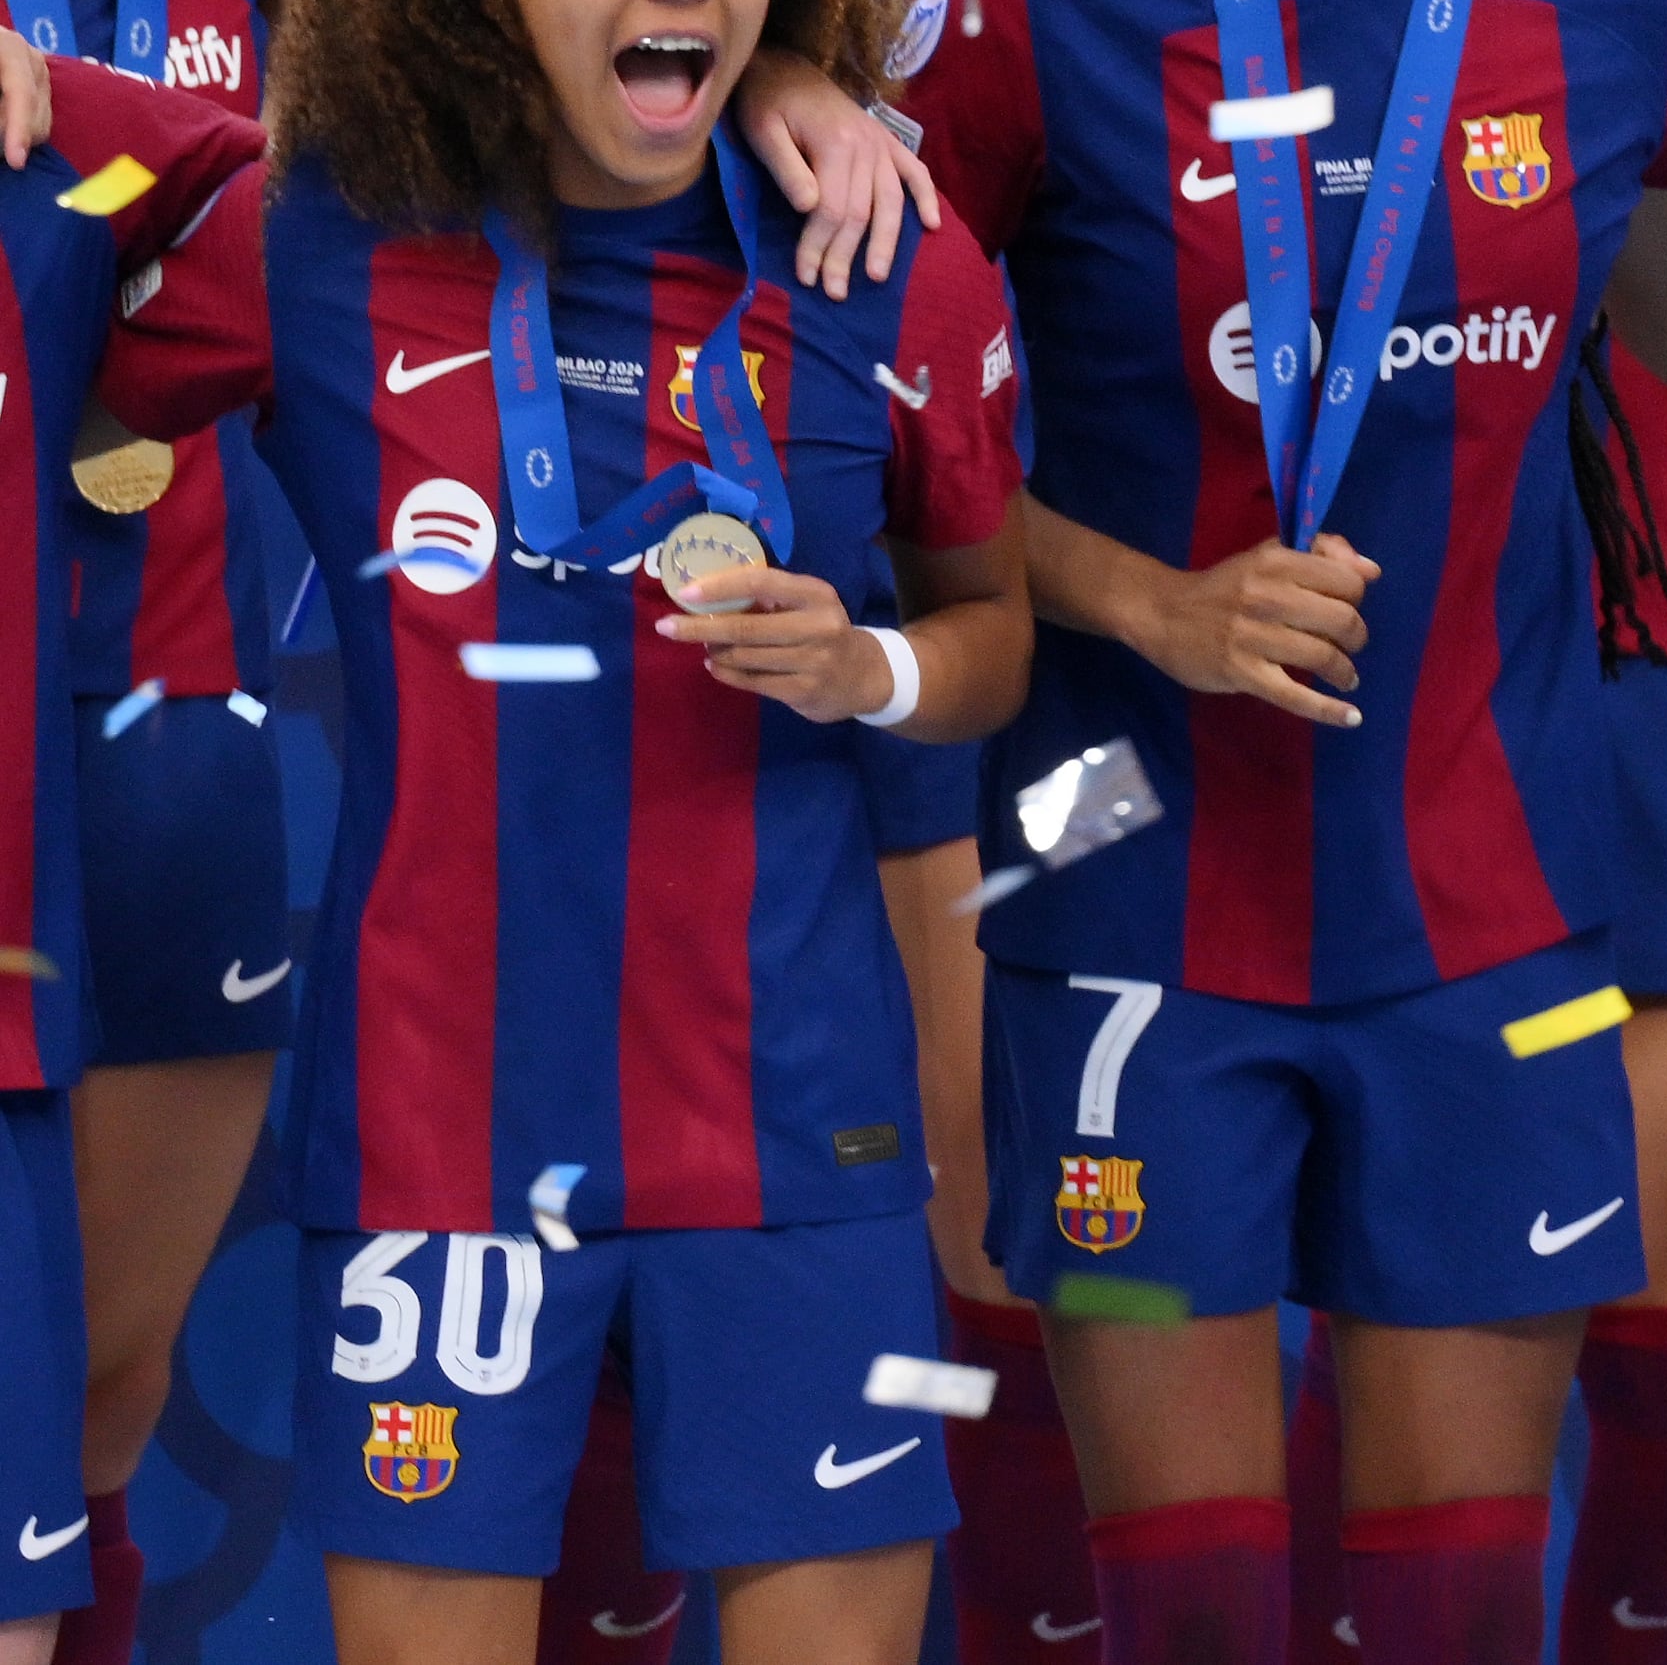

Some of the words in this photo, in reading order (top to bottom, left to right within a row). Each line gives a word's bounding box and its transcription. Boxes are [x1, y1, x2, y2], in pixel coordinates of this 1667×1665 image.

[165, 24, 242, 91] tify
[1388, 93, 1431, 195] FINAL
[1261, 175, 1288, 284] FINAL
[1379, 207, 1399, 235] 24
[1357, 238, 1392, 312] BILBAO
[511, 314, 537, 393] BILBAO
[608, 359, 645, 378] 2024
[1379, 305, 1557, 382] potify
[1067, 971, 1164, 1139] 7
[331, 1229, 544, 1396] 30
[391, 1444, 430, 1457] FCB
